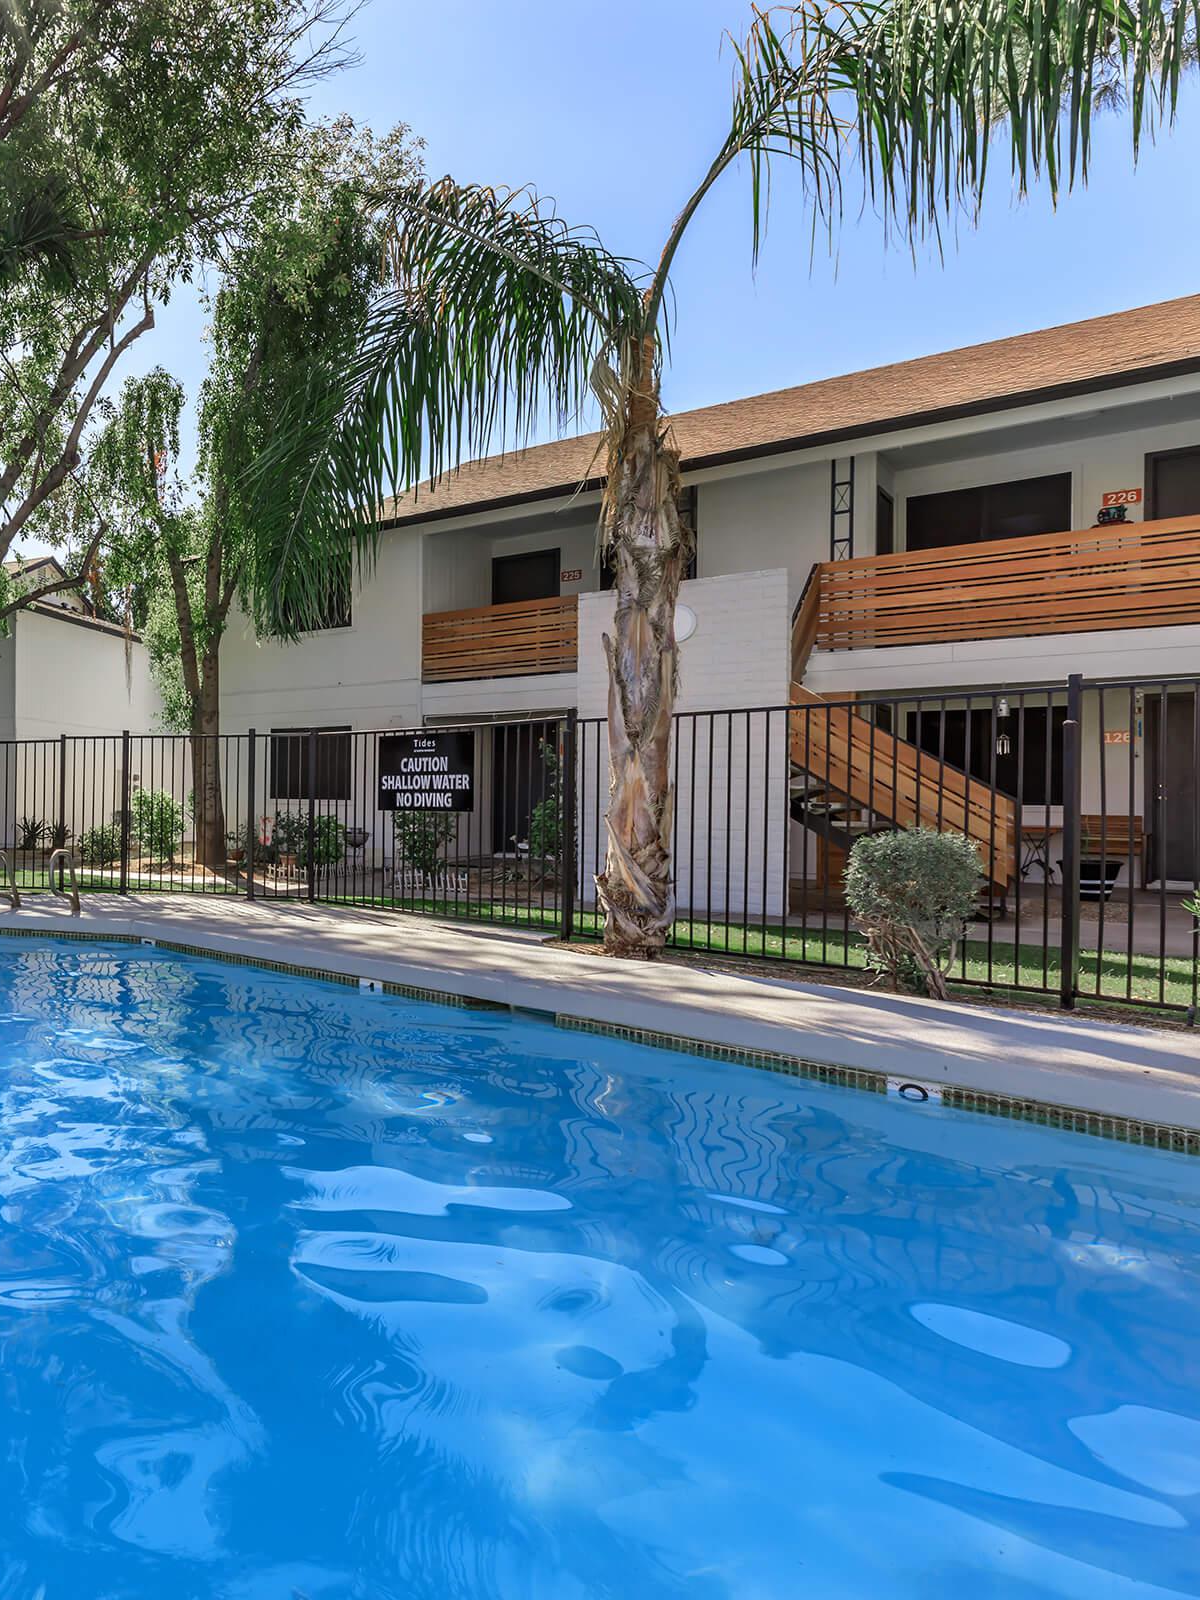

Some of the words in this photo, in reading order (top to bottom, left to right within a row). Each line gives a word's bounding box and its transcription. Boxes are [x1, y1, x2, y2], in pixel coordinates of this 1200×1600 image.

[1107, 491, 1137, 505] 226
[563, 571, 580, 580] 225
[413, 739, 436, 747] Tides
[1104, 732, 1131, 743] 126
[400, 756, 448, 772] CAUTION
[381, 775, 431, 790] SHALLOW
[432, 774, 470, 790] WATER
[396, 793, 412, 807] NO
[413, 792, 452, 808] DIVING
